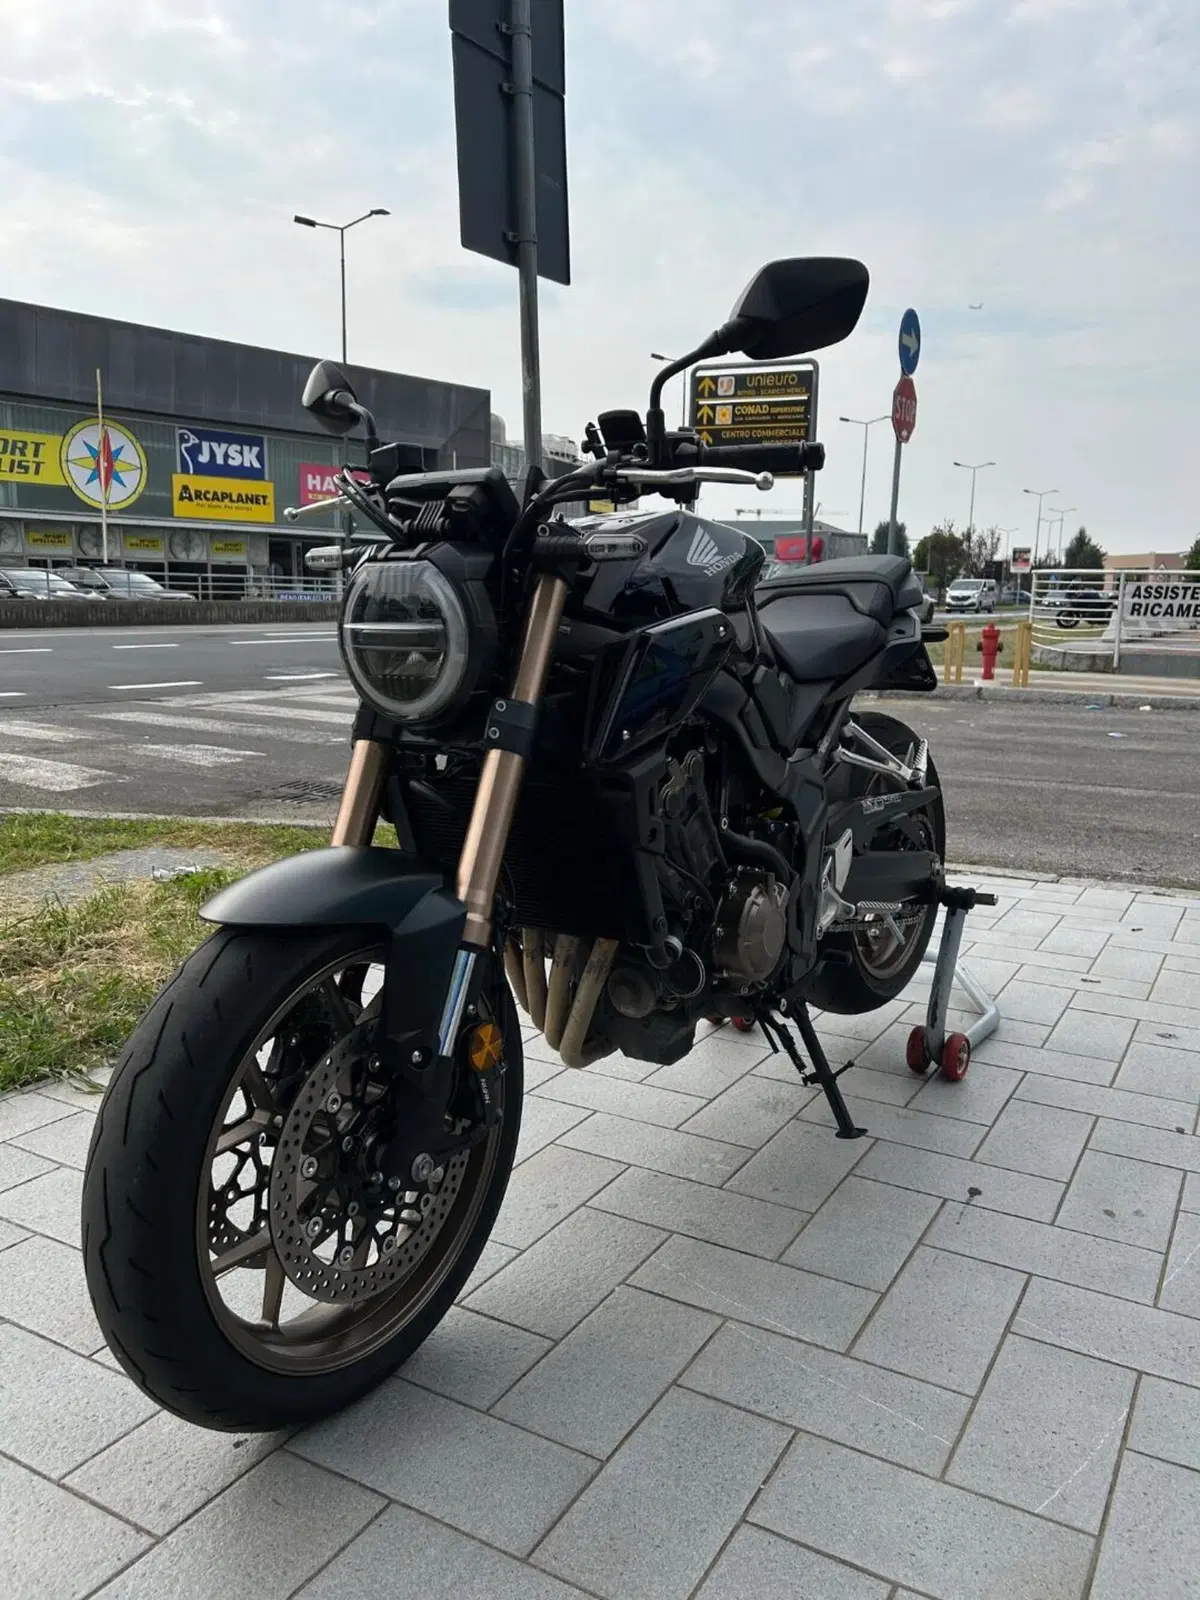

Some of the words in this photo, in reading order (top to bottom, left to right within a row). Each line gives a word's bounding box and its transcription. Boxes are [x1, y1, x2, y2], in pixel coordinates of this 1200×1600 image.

[746, 373, 798, 388] unieuro
[734, 404, 770, 416] CONAD
[721, 429, 750, 439] CENTRO
[752, 428, 805, 437] COMMERCIALE
[197, 440, 262, 469] JYSK
[178, 484, 269, 506] ARCAPLANET
[703, 551, 744, 577] HONDA
[1131, 585, 1200, 600] ASSISTE
